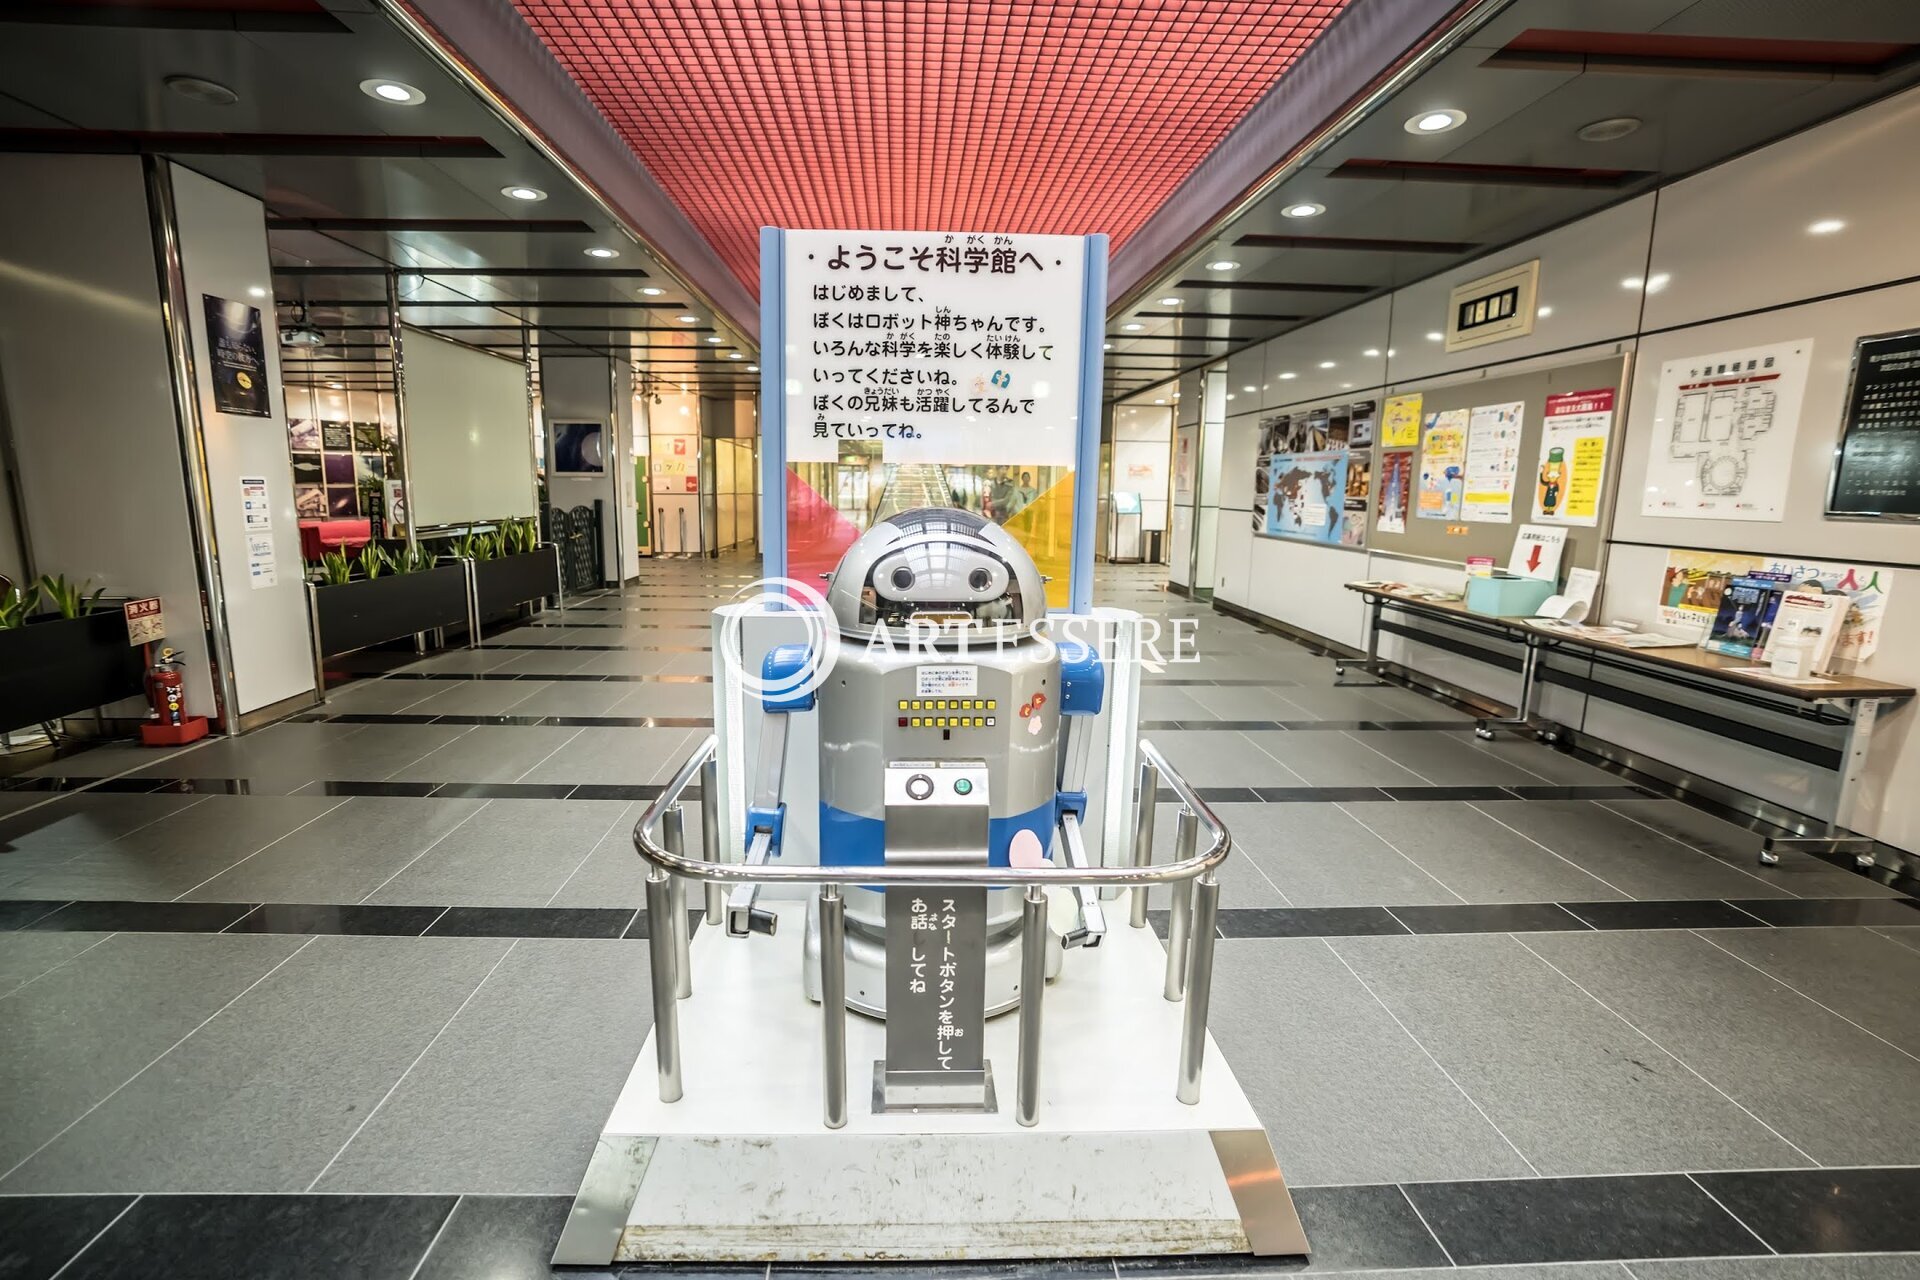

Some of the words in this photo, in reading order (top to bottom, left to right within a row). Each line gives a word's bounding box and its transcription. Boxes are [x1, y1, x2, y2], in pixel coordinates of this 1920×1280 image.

[944, 234, 954, 245] か
[966, 235, 985, 245] がく
[994, 235, 1013, 245] かん
[812, 284, 925, 303] はじめまして、
[935, 306, 951, 314] しん
[813, 312, 1046, 333] ぼくはロボット神ちゃんです。
[886, 332, 894, 340] か
[899, 332, 915, 341] がく
[934, 333, 951, 341] たの
[813, 340, 1054, 361] いろんな科学を楽しく体験して
[813, 368, 959, 386] いってくださいね。
[813, 395, 1035, 414] ぼくの兄妹も活躍してるんで
[817, 413, 825, 421] み
[813, 421, 923, 439] 見ていってね。
[936, 898, 957, 1070] スタートボタンを押して
[954, 1028, 964, 1037] お
